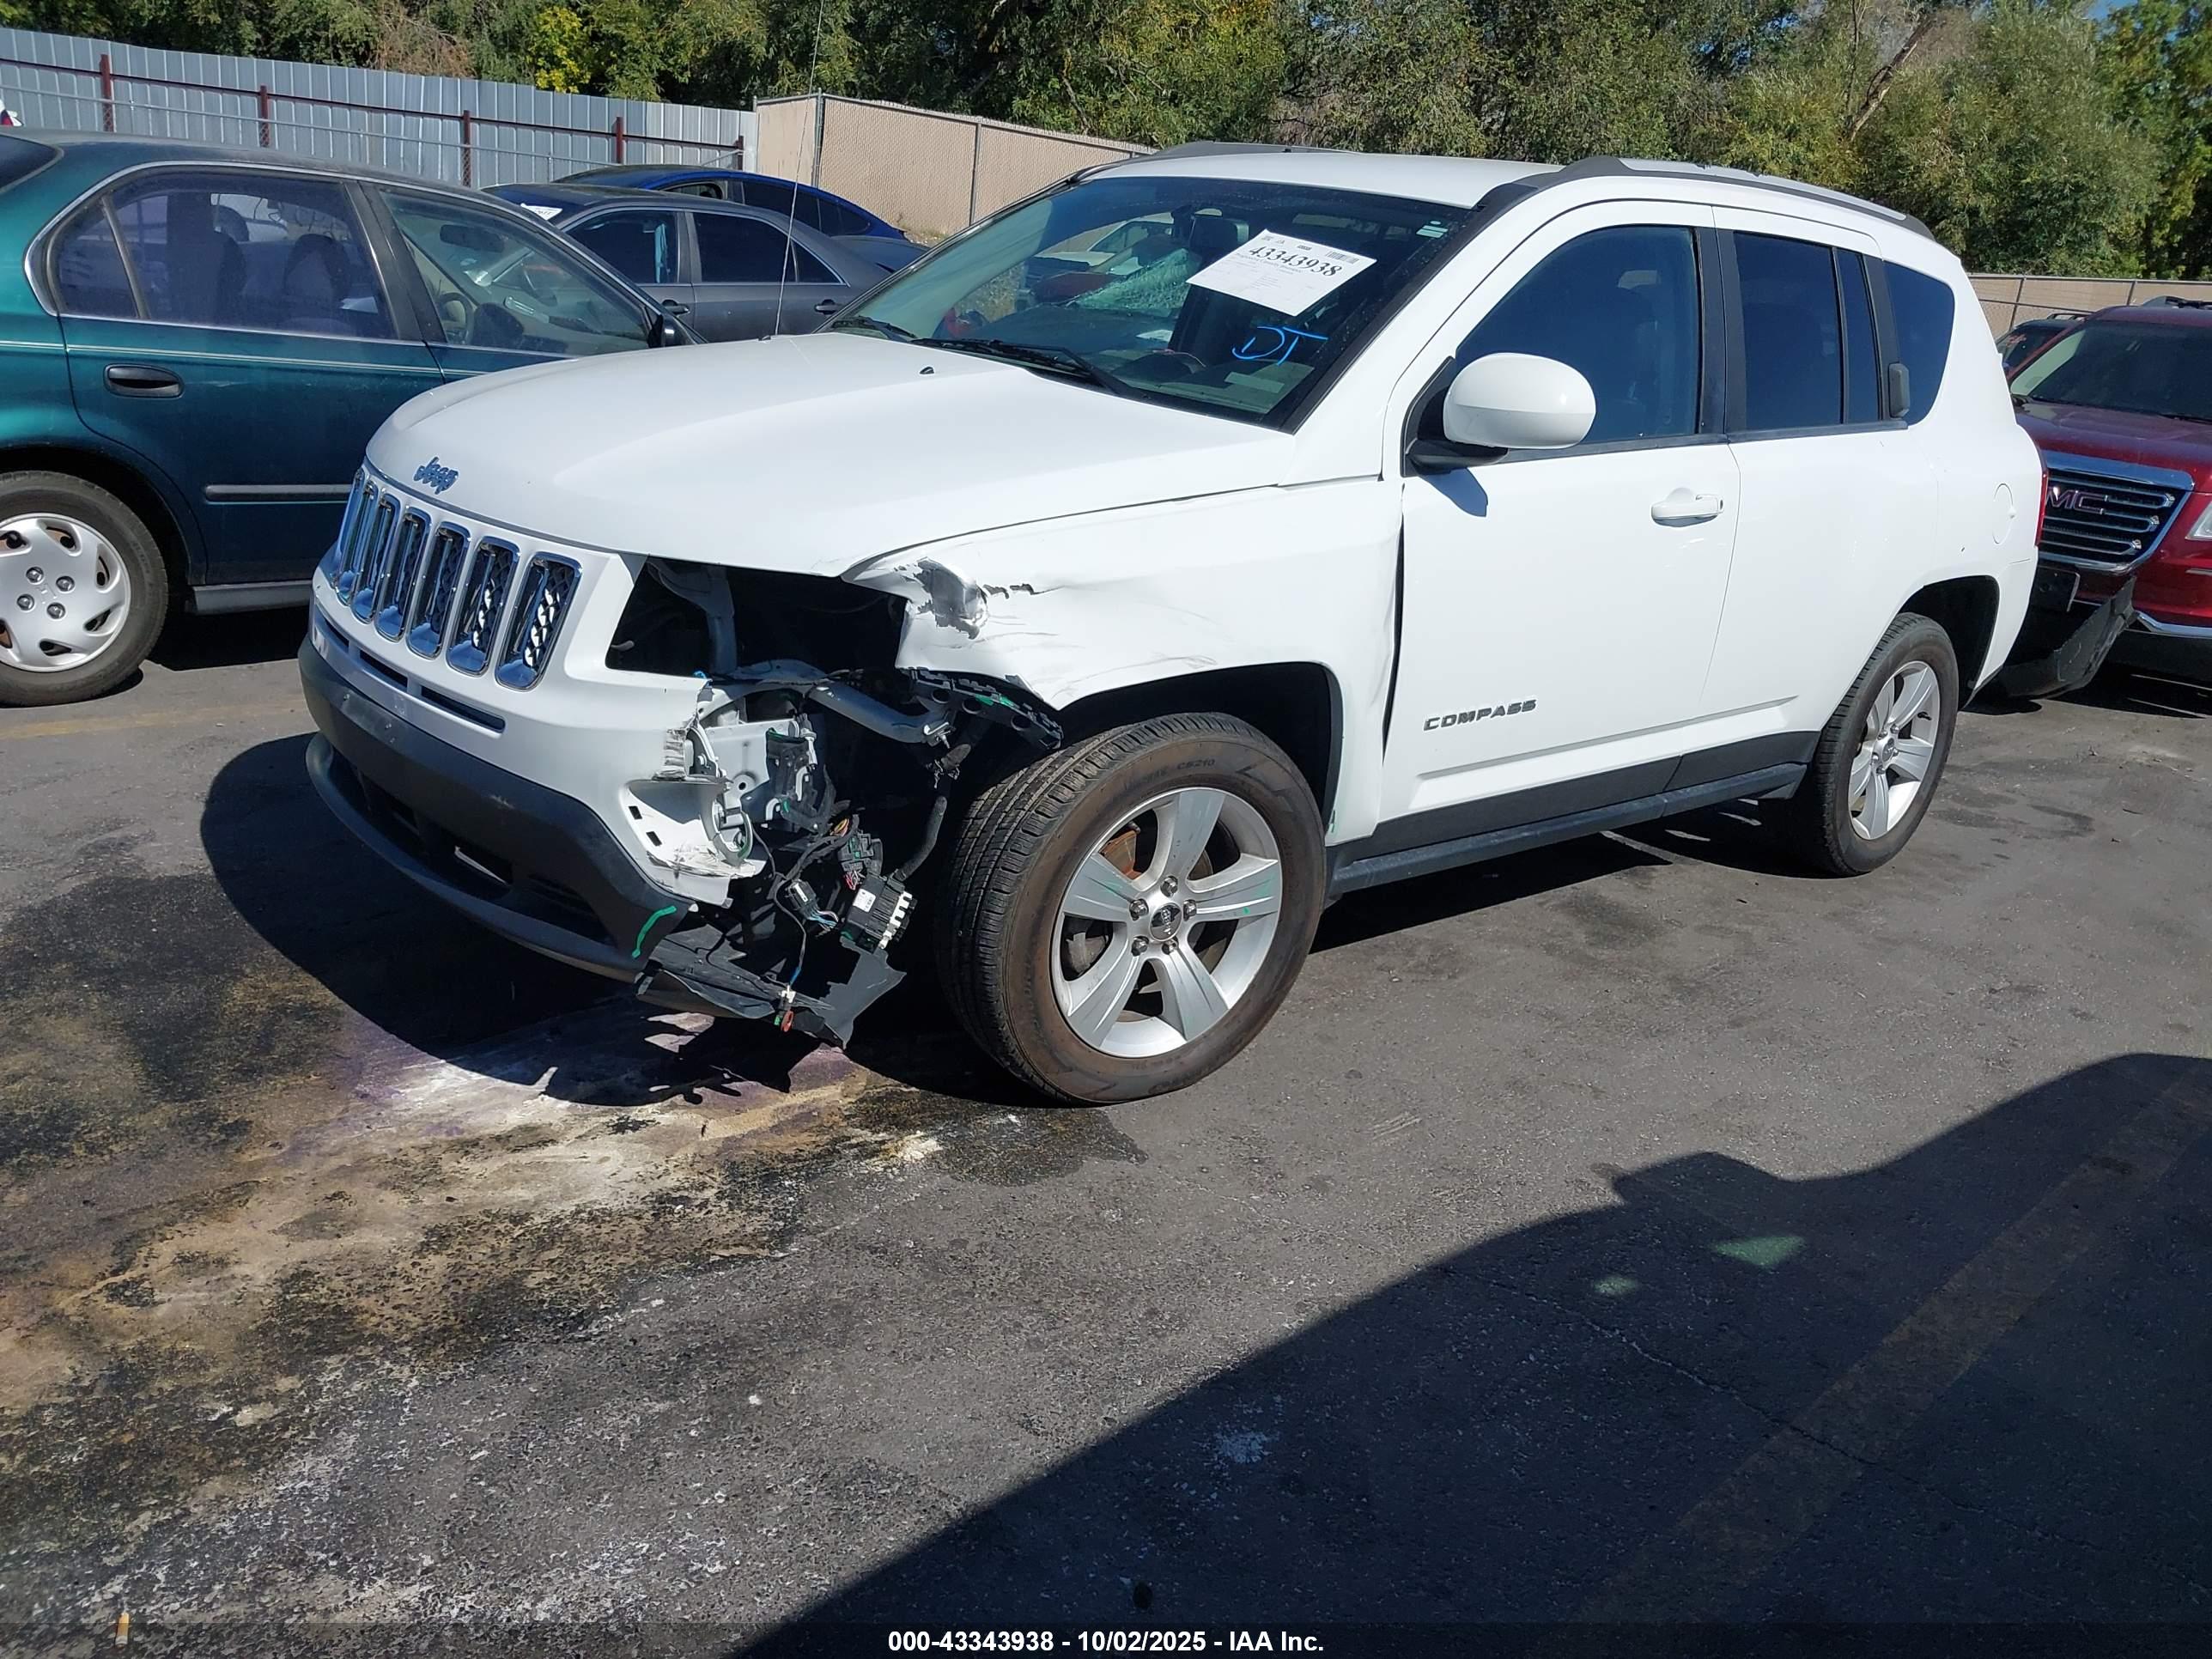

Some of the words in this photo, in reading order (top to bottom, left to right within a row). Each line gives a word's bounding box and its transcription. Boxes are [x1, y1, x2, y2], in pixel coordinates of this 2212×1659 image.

[1249, 246, 1343, 276] 43343938
[1231, 325, 1330, 366] DT
[413, 456, 459, 495] Jeep
[2045, 485, 2108, 515] MC
[1423, 699, 1537, 732] COMPASS
